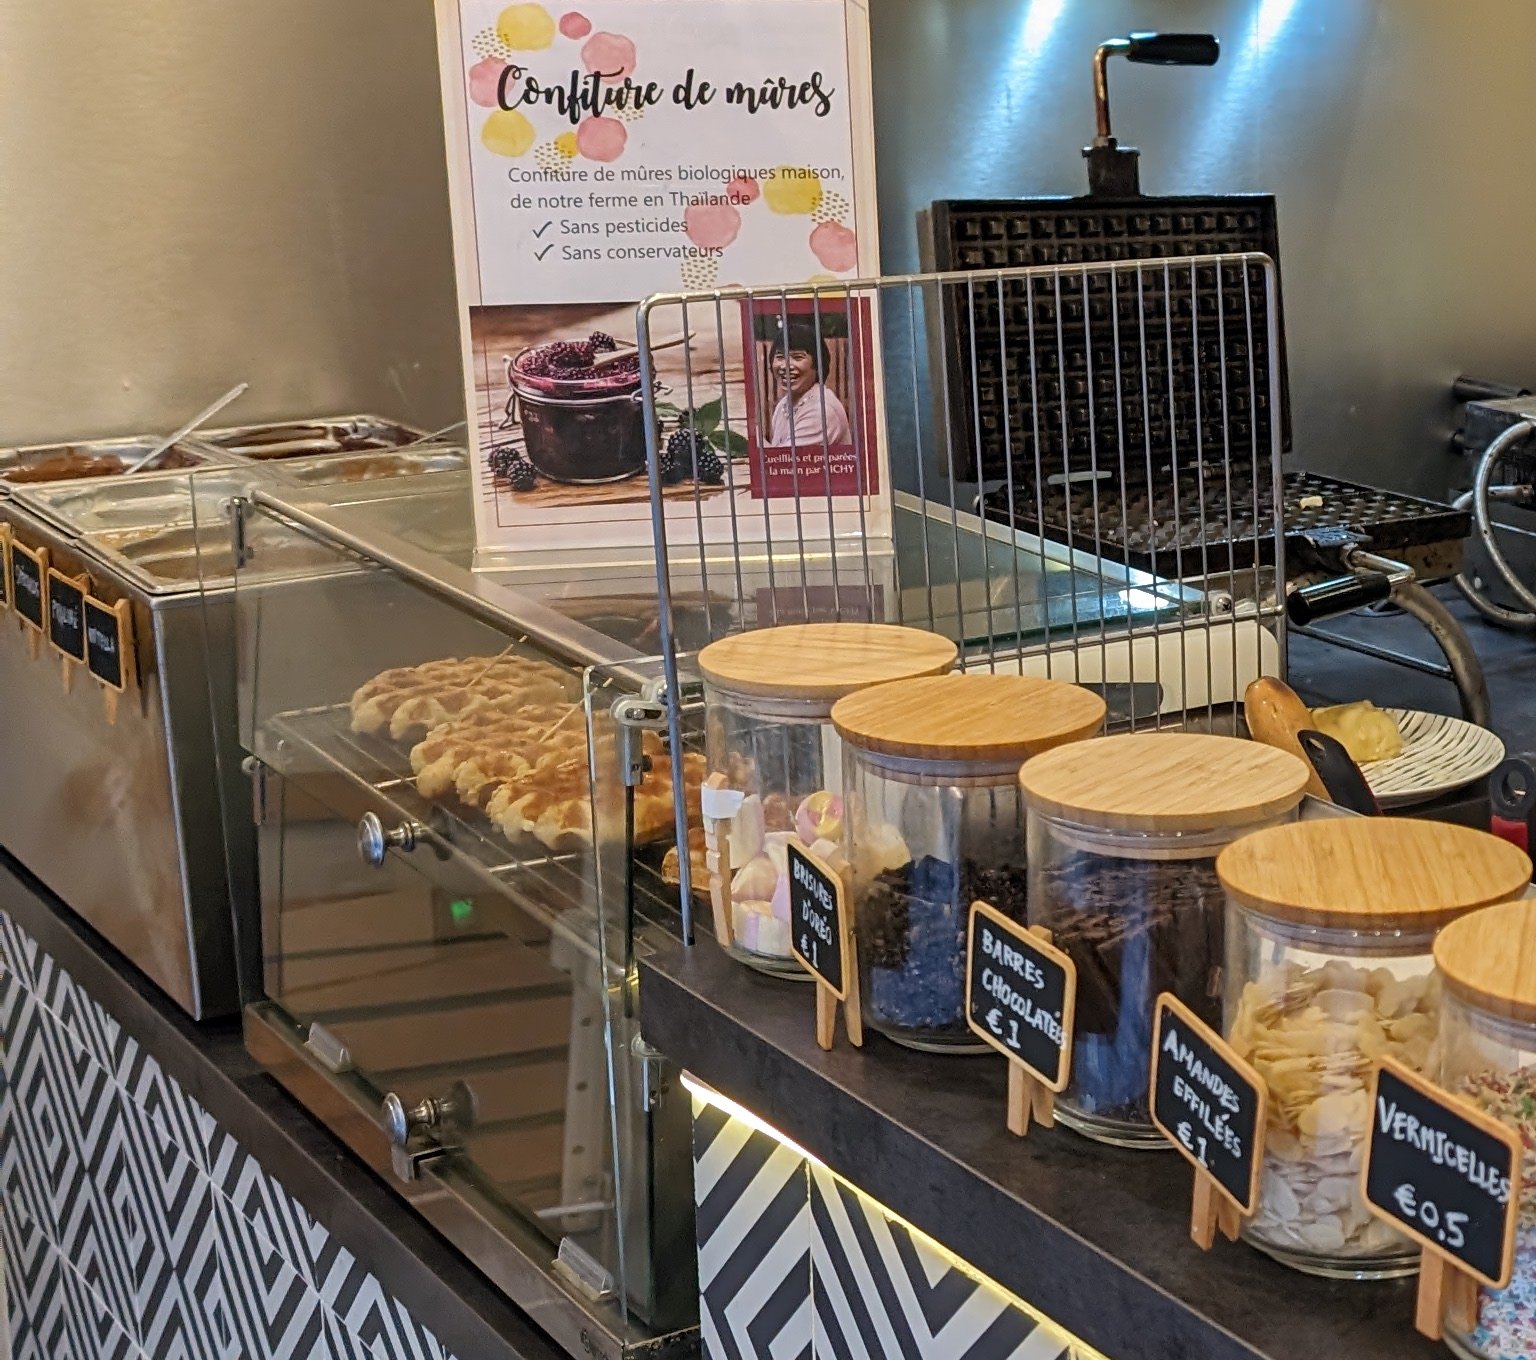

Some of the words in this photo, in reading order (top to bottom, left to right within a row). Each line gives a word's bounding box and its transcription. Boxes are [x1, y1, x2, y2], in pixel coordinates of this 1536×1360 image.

[497, 64, 664, 125] Confiture
[672, 68, 717, 110] de
[725, 71, 836, 117] mûres
[508, 166, 589, 183] Confiture
[594, 166, 616, 182] de
[621, 164, 673, 182] mûres
[678, 164, 776, 186] biologiques
[781, 165, 846, 183] maison,
[510, 193, 532, 209] de
[537, 194, 583, 209] notre
[588, 191, 638, 208] ferme
[643, 195, 664, 207] en
[671, 191, 750, 207] Thaïlande
[560, 220, 600, 234] Sans
[605, 218, 689, 237] pesticides
[562, 245, 601, 260] Sans
[606, 244, 723, 260] conservateurs
[982, 928, 1045, 989] BARRES
[1163, 1029, 1240, 1113] AMANDES
[1173, 1075, 1242, 1158] EFFILÉES
[1378, 1095, 1512, 1203] VERMICELLES
